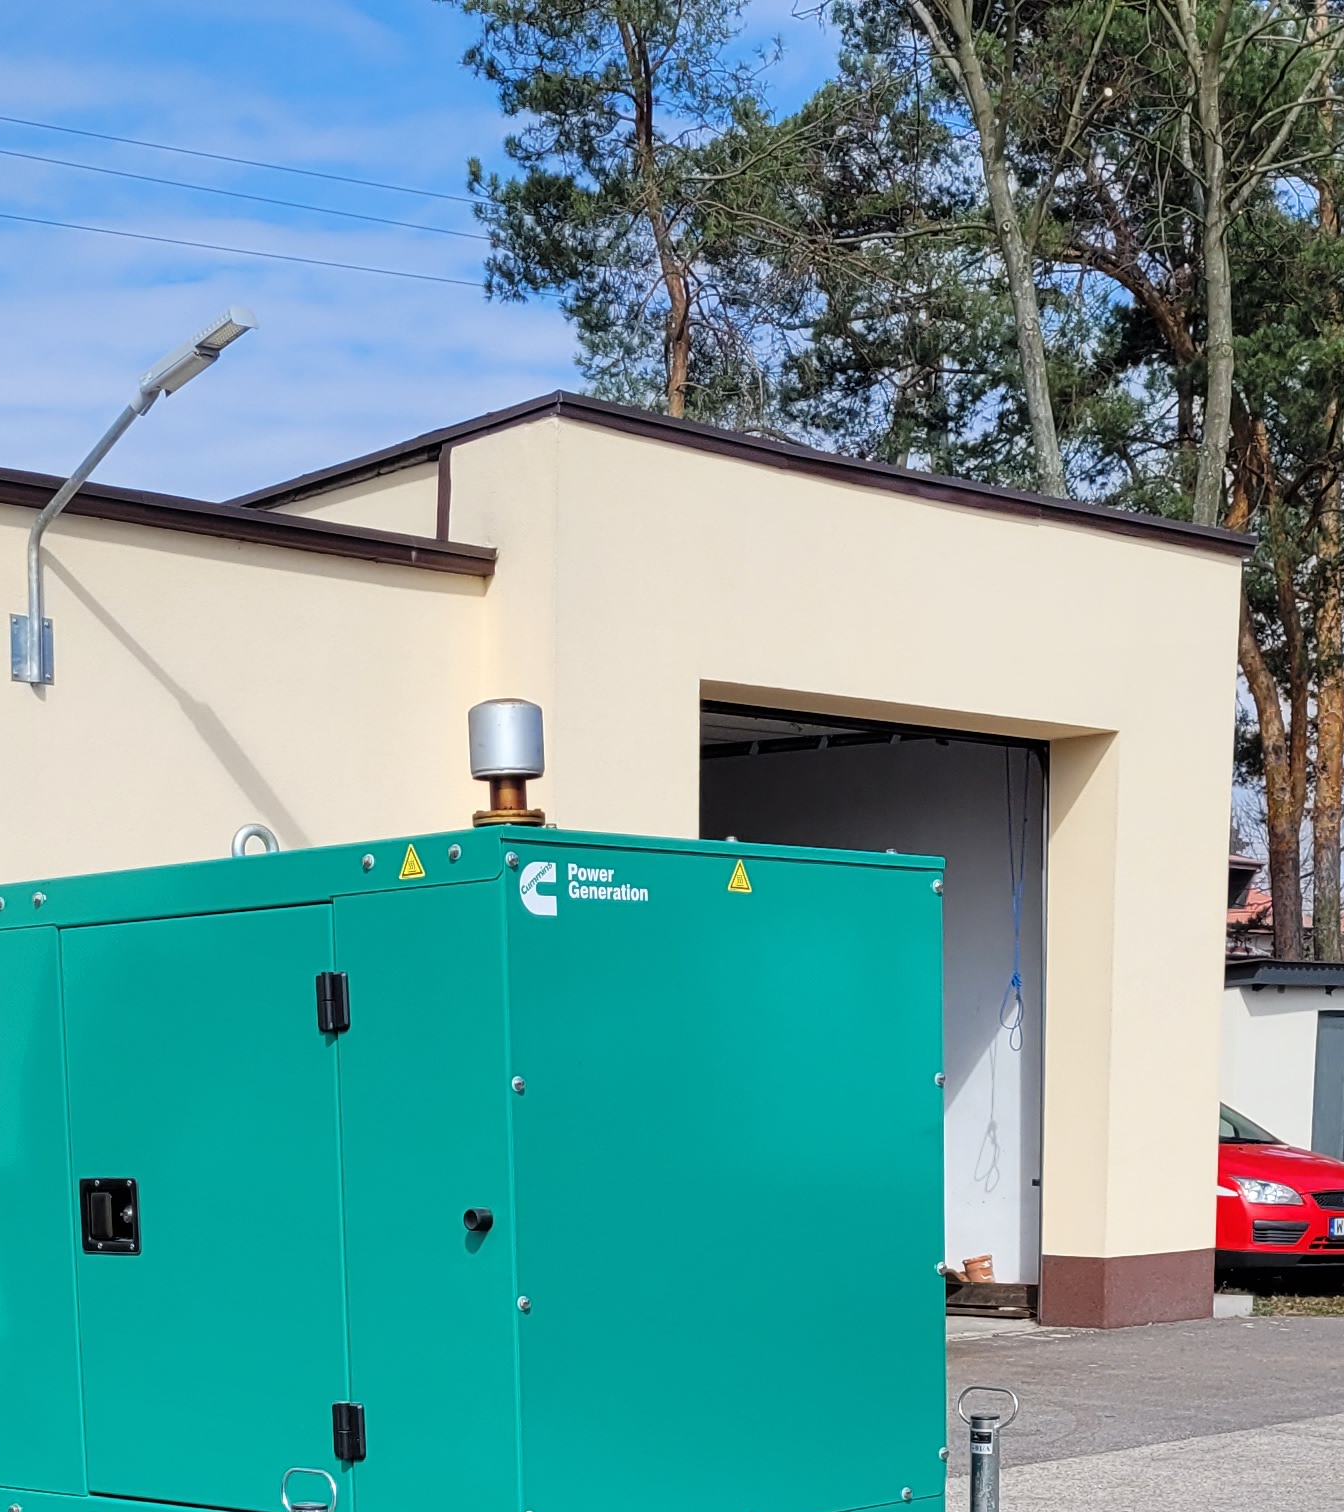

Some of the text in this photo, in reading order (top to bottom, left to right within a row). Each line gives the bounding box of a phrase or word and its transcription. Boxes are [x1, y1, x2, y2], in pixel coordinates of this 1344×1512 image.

[520, 861, 553, 896] Cummins
[567, 862, 615, 883] Power
[567, 881, 649, 902] Generation
